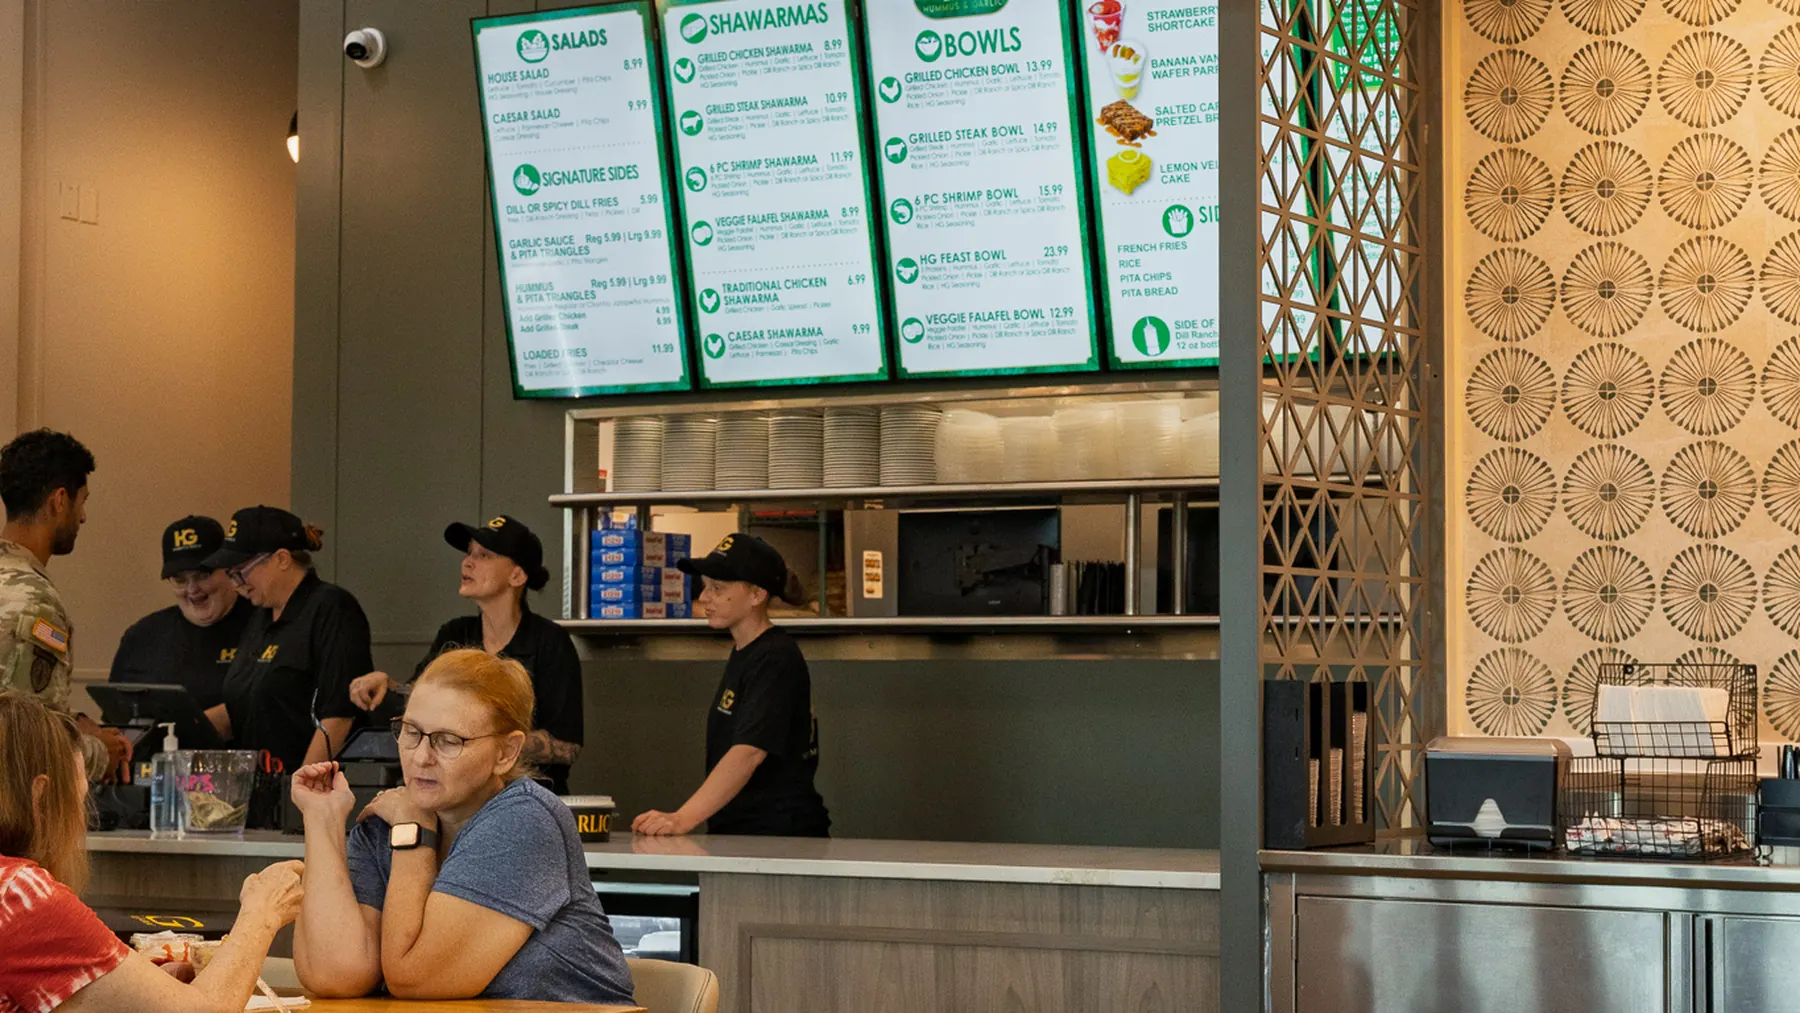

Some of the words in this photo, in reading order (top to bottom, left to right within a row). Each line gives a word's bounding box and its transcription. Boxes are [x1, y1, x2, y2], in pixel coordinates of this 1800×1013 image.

[922, 2, 961, 13] HUMMUS
[709, 2, 828, 36] SHAWARMAS
[1148, 17, 1215, 32] SHORTCAKE
[551, 28, 608, 51] SALADS
[944, 26, 1022, 58] BOWLS
[697, 51, 728, 65] GRILLED
[728, 47, 765, 62] CHICKEN
[765, 42, 814, 59] SHAWARMA
[823, 39, 842, 51] 8.99
[487, 71, 518, 84] HOUSE
[519, 68, 550, 81] SALAD
[623, 58, 643, 71] 8.99
[1151, 56, 1197, 69] BANANA
[904, 70, 942, 84] GRILLED
[944, 65, 989, 82] CHICKEN
[990, 62, 1020, 78] BOWL
[1026, 60, 1053, 73] 13.99
[1152, 67, 1191, 80] WAFER
[492, 111, 529, 124] CAESAR
[530, 108, 561, 120] SALAD
[627, 100, 647, 111] 9.99
[705, 103, 736, 116] GRILLED
[736, 100, 760, 113] STEAK
[761, 96, 808, 110] SHAWARMA
[825, 92, 848, 104] 10.99
[1155, 103, 1197, 116] SALTED
[1156, 114, 1203, 127] PRETZEL
[908, 130, 953, 145] GRILLED
[955, 127, 988, 142] STEAK
[991, 125, 1025, 139] BOWL
[1033, 122, 1058, 134] 14.99
[709, 163, 716, 173] 6
[717, 162, 729, 173] PC
[730, 159, 762, 172] SHRIMP
[764, 154, 818, 169] SHAWARMA
[830, 150, 854, 162] 11.99
[1160, 161, 1199, 174] LEMON
[542, 166, 607, 187] SIGNATURE
[608, 164, 639, 181] SIDES
[1160, 172, 1191, 185] CAKE
[914, 195, 921, 205] 6
[923, 193, 939, 205] PC
[942, 190, 983, 204] SHRIMP
[986, 188, 1018, 201] BOWL
[1038, 183, 1064, 197] 15.99
[505, 205, 526, 215] DILL
[527, 203, 541, 213] OR
[542, 202, 569, 212] SPICY
[571, 200, 591, 210] DILL
[592, 197, 619, 208] FRIES
[640, 194, 658, 205] 5.99
[714, 215, 746, 228] VEGGIE
[747, 212, 779, 225] FALAFEL
[780, 208, 829, 222] SHAWARMA
[841, 206, 859, 217] 8.99
[509, 238, 543, 249] GARLIC
[544, 235, 575, 246] SAUCE
[586, 234, 602, 245] Reg
[604, 232, 621, 242] 5.99
[628, 231, 643, 243] Lrg
[643, 229, 662, 239] 9.99
[1117, 242, 1157, 254] FRENCH
[1159, 240, 1188, 252] FRIES
[511, 250, 517, 260] &
[519, 249, 537, 259] PITA
[540, 245, 590, 258] TRIANGLES
[919, 254, 937, 265] HG
[940, 251, 971, 264] FEAST
[973, 249, 1007, 261] BOWL
[1043, 245, 1069, 257] 23.99
[1119, 258, 1141, 269] RICE
[515, 282, 554, 293] HUMMUS
[591, 279, 608, 289] Reg
[609, 277, 627, 287] 5.99
[633, 277, 648, 287] Lrg
[648, 274, 667, 284] 9.99
[722, 280, 782, 294] TRADITIONAL
[784, 277, 827, 290] CHICKEN
[847, 273, 866, 286] 6.99
[1120, 273, 1141, 283] PITA
[1143, 271, 1172, 282] CHIPS
[517, 294, 523, 304] &
[525, 293, 544, 303] PITA
[547, 290, 597, 301] TRIANGLES
[724, 293, 780, 306] SHAWARMA
[1121, 288, 1142, 298] PITA
[1144, 286, 1179, 297] BREAD
[519, 314, 533, 323] Add
[558, 310, 586, 321] Chicken
[925, 312, 966, 325] VEGGIE
[968, 310, 1011, 323] FALAFEL
[1014, 308, 1045, 321] BOWL
[1049, 306, 1074, 318] 12.99
[1174, 319, 1198, 330] SIDE
[1202, 317, 1216, 329] OF
[520, 324, 534, 333] Add
[727, 330, 765, 342] CAESAR
[766, 326, 824, 340] SHAWARMA
[852, 323, 870, 334] 9.99
[1174, 330, 1188, 340] Dill
[1191, 329, 1219, 340] Ranch
[523, 349, 560, 361] LOADED
[652, 343, 674, 354] 11.99
[1177, 341, 1186, 350] 12
[1188, 341, 1197, 350] oz
[226, 519, 238, 538] G
[487, 516, 507, 529] G
[173, 528, 199, 547] HG
[220, 648, 238, 661] H
